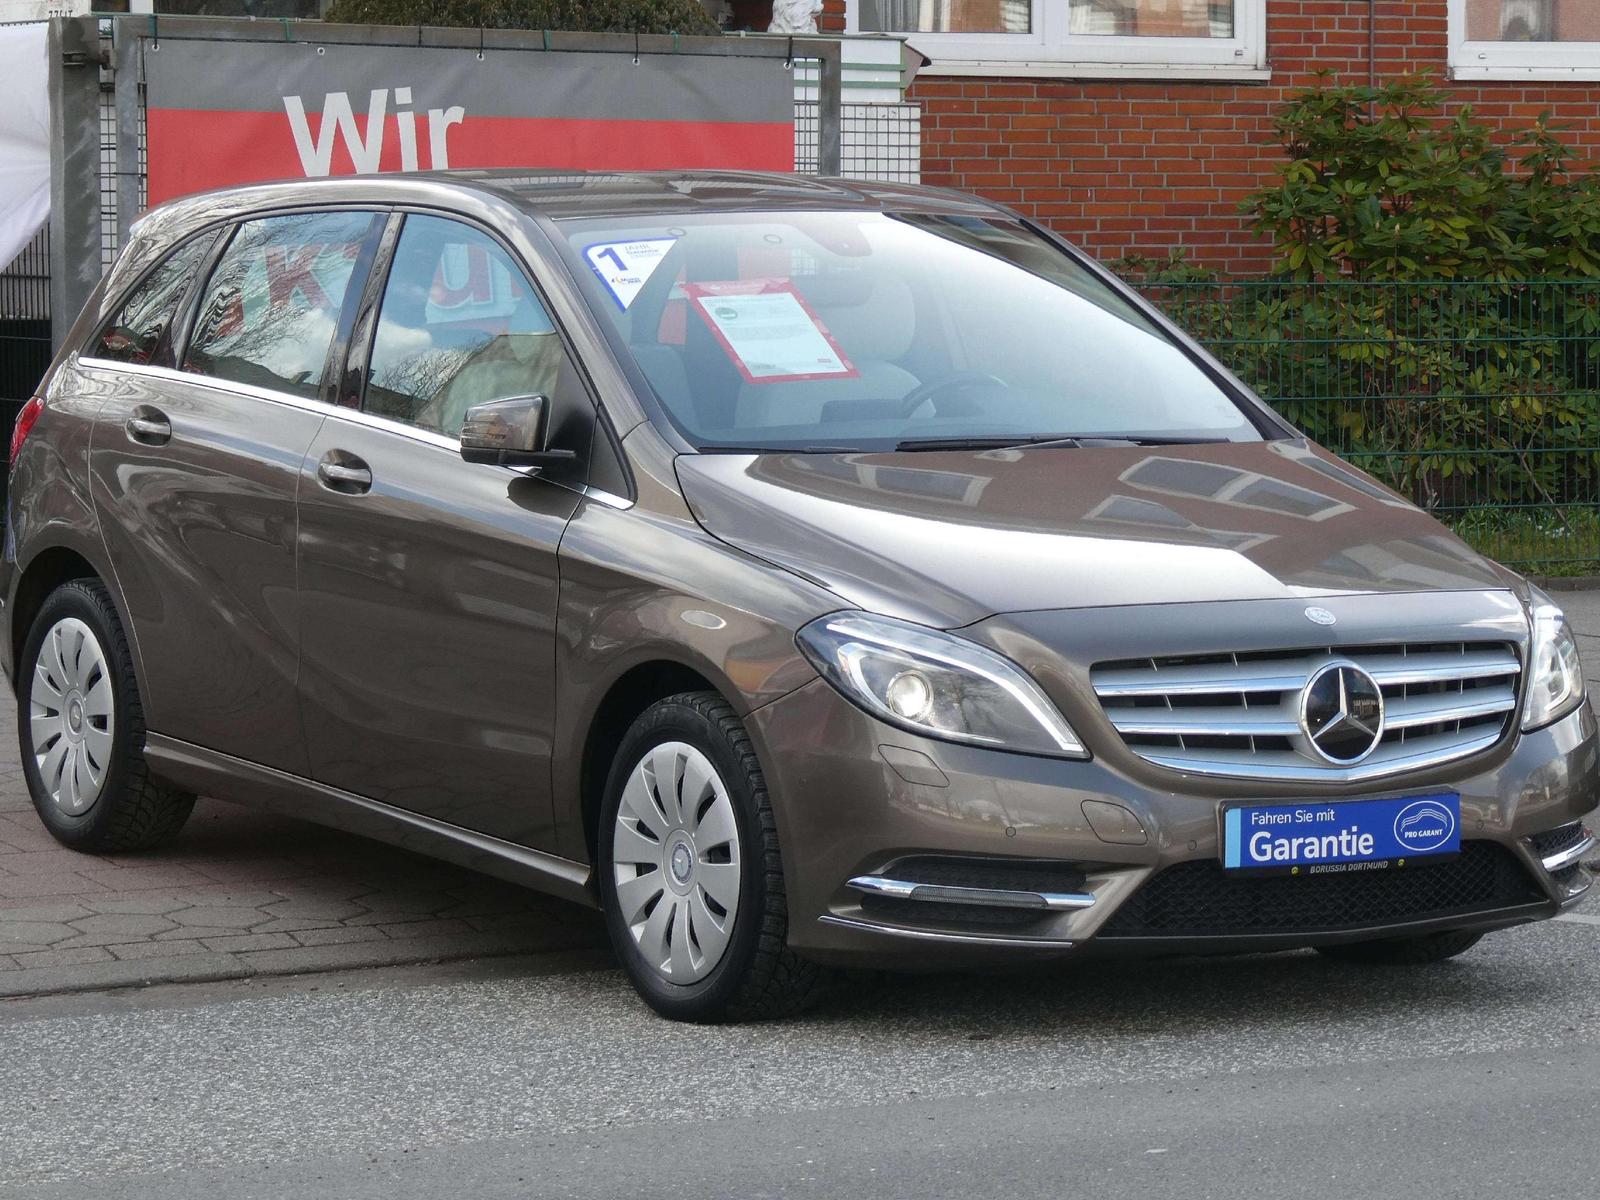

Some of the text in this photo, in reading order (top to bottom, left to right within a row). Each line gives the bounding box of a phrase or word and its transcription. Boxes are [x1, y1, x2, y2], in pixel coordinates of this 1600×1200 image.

[283, 87, 465, 177] Wir
[597, 247, 628, 271] 1
[1251, 808, 1336, 826] Fahren Sie mit
[1249, 826, 1374, 862] Garantie
[1404, 828, 1443, 839] PRO GARANT
[1310, 860, 1389, 874] BORUSSIA DORTMUND
